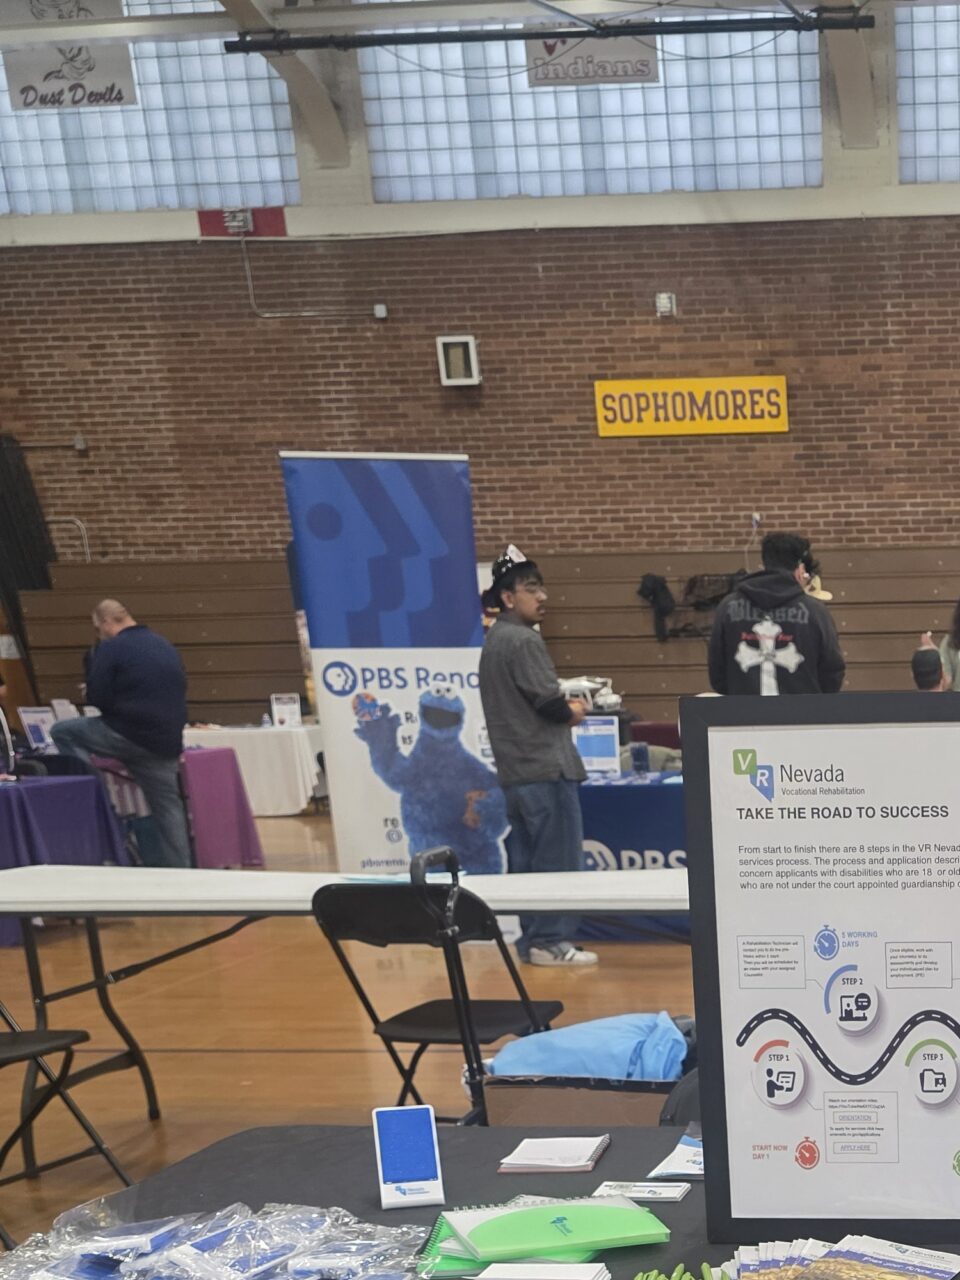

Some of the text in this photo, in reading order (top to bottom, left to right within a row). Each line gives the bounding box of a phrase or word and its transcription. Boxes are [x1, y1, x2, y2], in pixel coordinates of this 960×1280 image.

[532, 55, 650, 80] Indians
[20, 82, 124, 107] Dust Devils
[602, 388, 781, 424] SOPHOMORES
[361, 667, 408, 689] PBS
[780, 764, 845, 783] Nevada
[782, 787, 865, 796] Vocational Rehabilitation
[736, 805, 949, 820] TAKE THE ROAD TO SUCCESS
[738, 845, 760, 854] From
[763, 845, 781, 853] start
[784, 845, 792, 853] to
[794, 844, 816, 853] finish
[818, 844, 840, 853] there
[859, 844, 865, 853] 8
[867, 844, 890, 854] steps
[892, 844, 900, 852] in
[902, 844, 915, 852] the
[918, 843, 932, 852] VR
[739, 857, 774, 866] services
[776, 858, 811, 867] process.
[814, 857, 831, 865] The
[833, 858, 866, 867] process
[868, 856, 885, 865] and
[886, 856, 932, 867] application
[775, 868, 818, 879] applicants
[820, 868, 837, 877] with
[839, 868, 884, 877] disabilities
[885, 868, 903, 876] who
[922, 868, 932, 876] 18
[740, 881, 758, 889] who
[776, 880, 790, 889] not
[791, 880, 816, 889] under
[818, 880, 832, 889] the
[833, 880, 855, 889] court
[857, 880, 899, 890] appointed
[901, 879, 955, 890] guardianship
[922, 1053, 937, 1061] STEP
